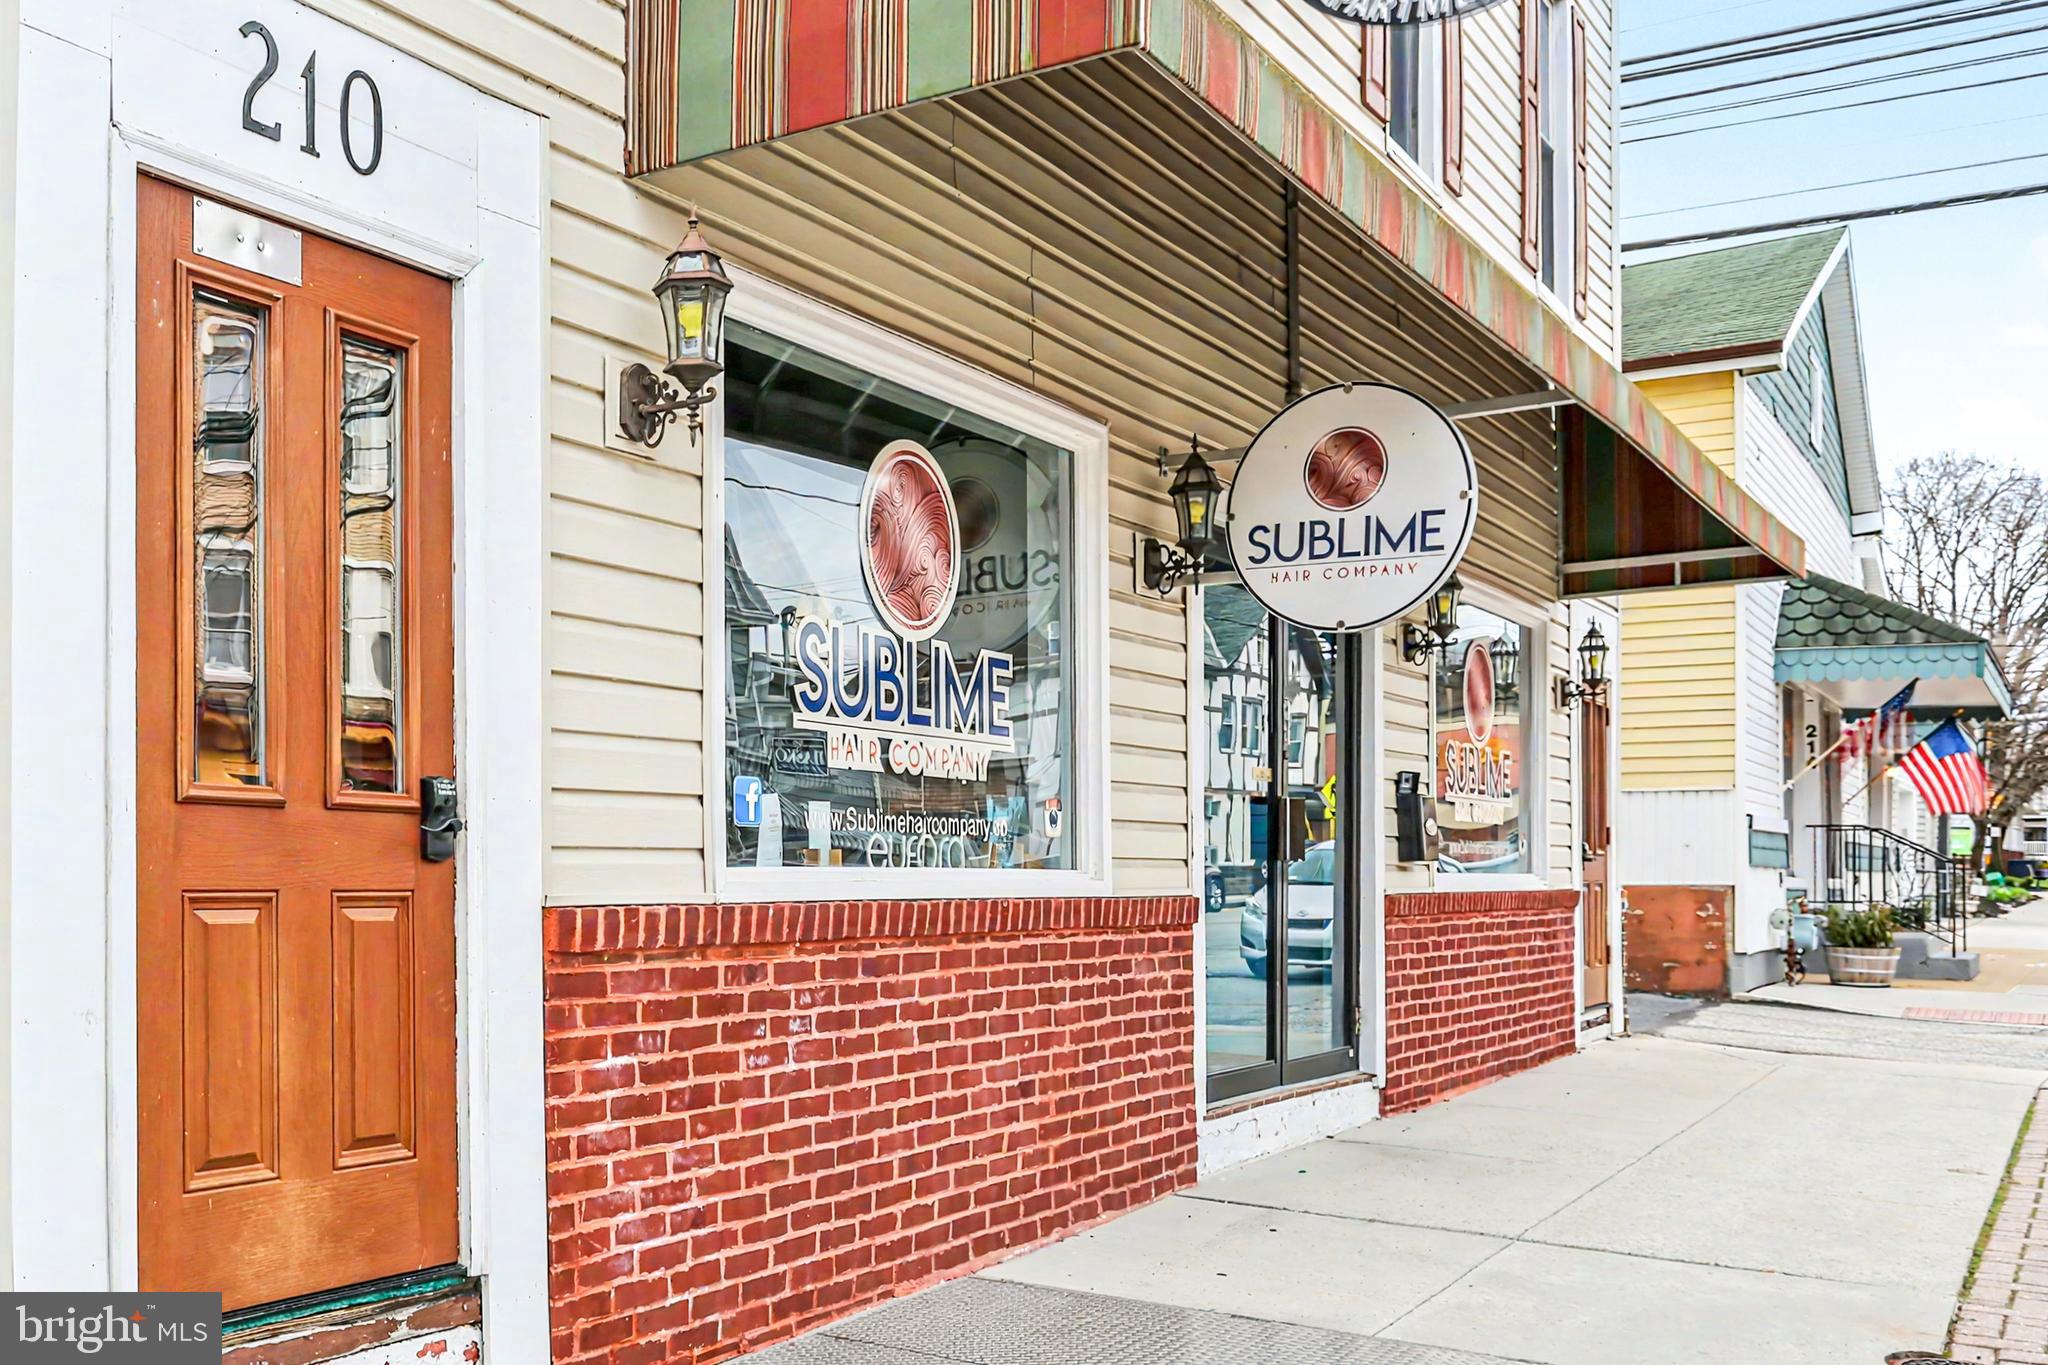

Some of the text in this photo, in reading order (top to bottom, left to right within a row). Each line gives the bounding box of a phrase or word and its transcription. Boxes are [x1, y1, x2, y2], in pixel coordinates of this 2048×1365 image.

[238, 20, 383, 175] 210
[1247, 508, 1447, 565] SUBLIME
[1270, 561, 1419, 585] HAIR COMPANY
[797, 617, 1012, 739] SUBLIME
[830, 735, 880, 765] HAIR
[892, 741, 989, 778] COMPANY
[1446, 741, 1512, 799] SUBLIME
